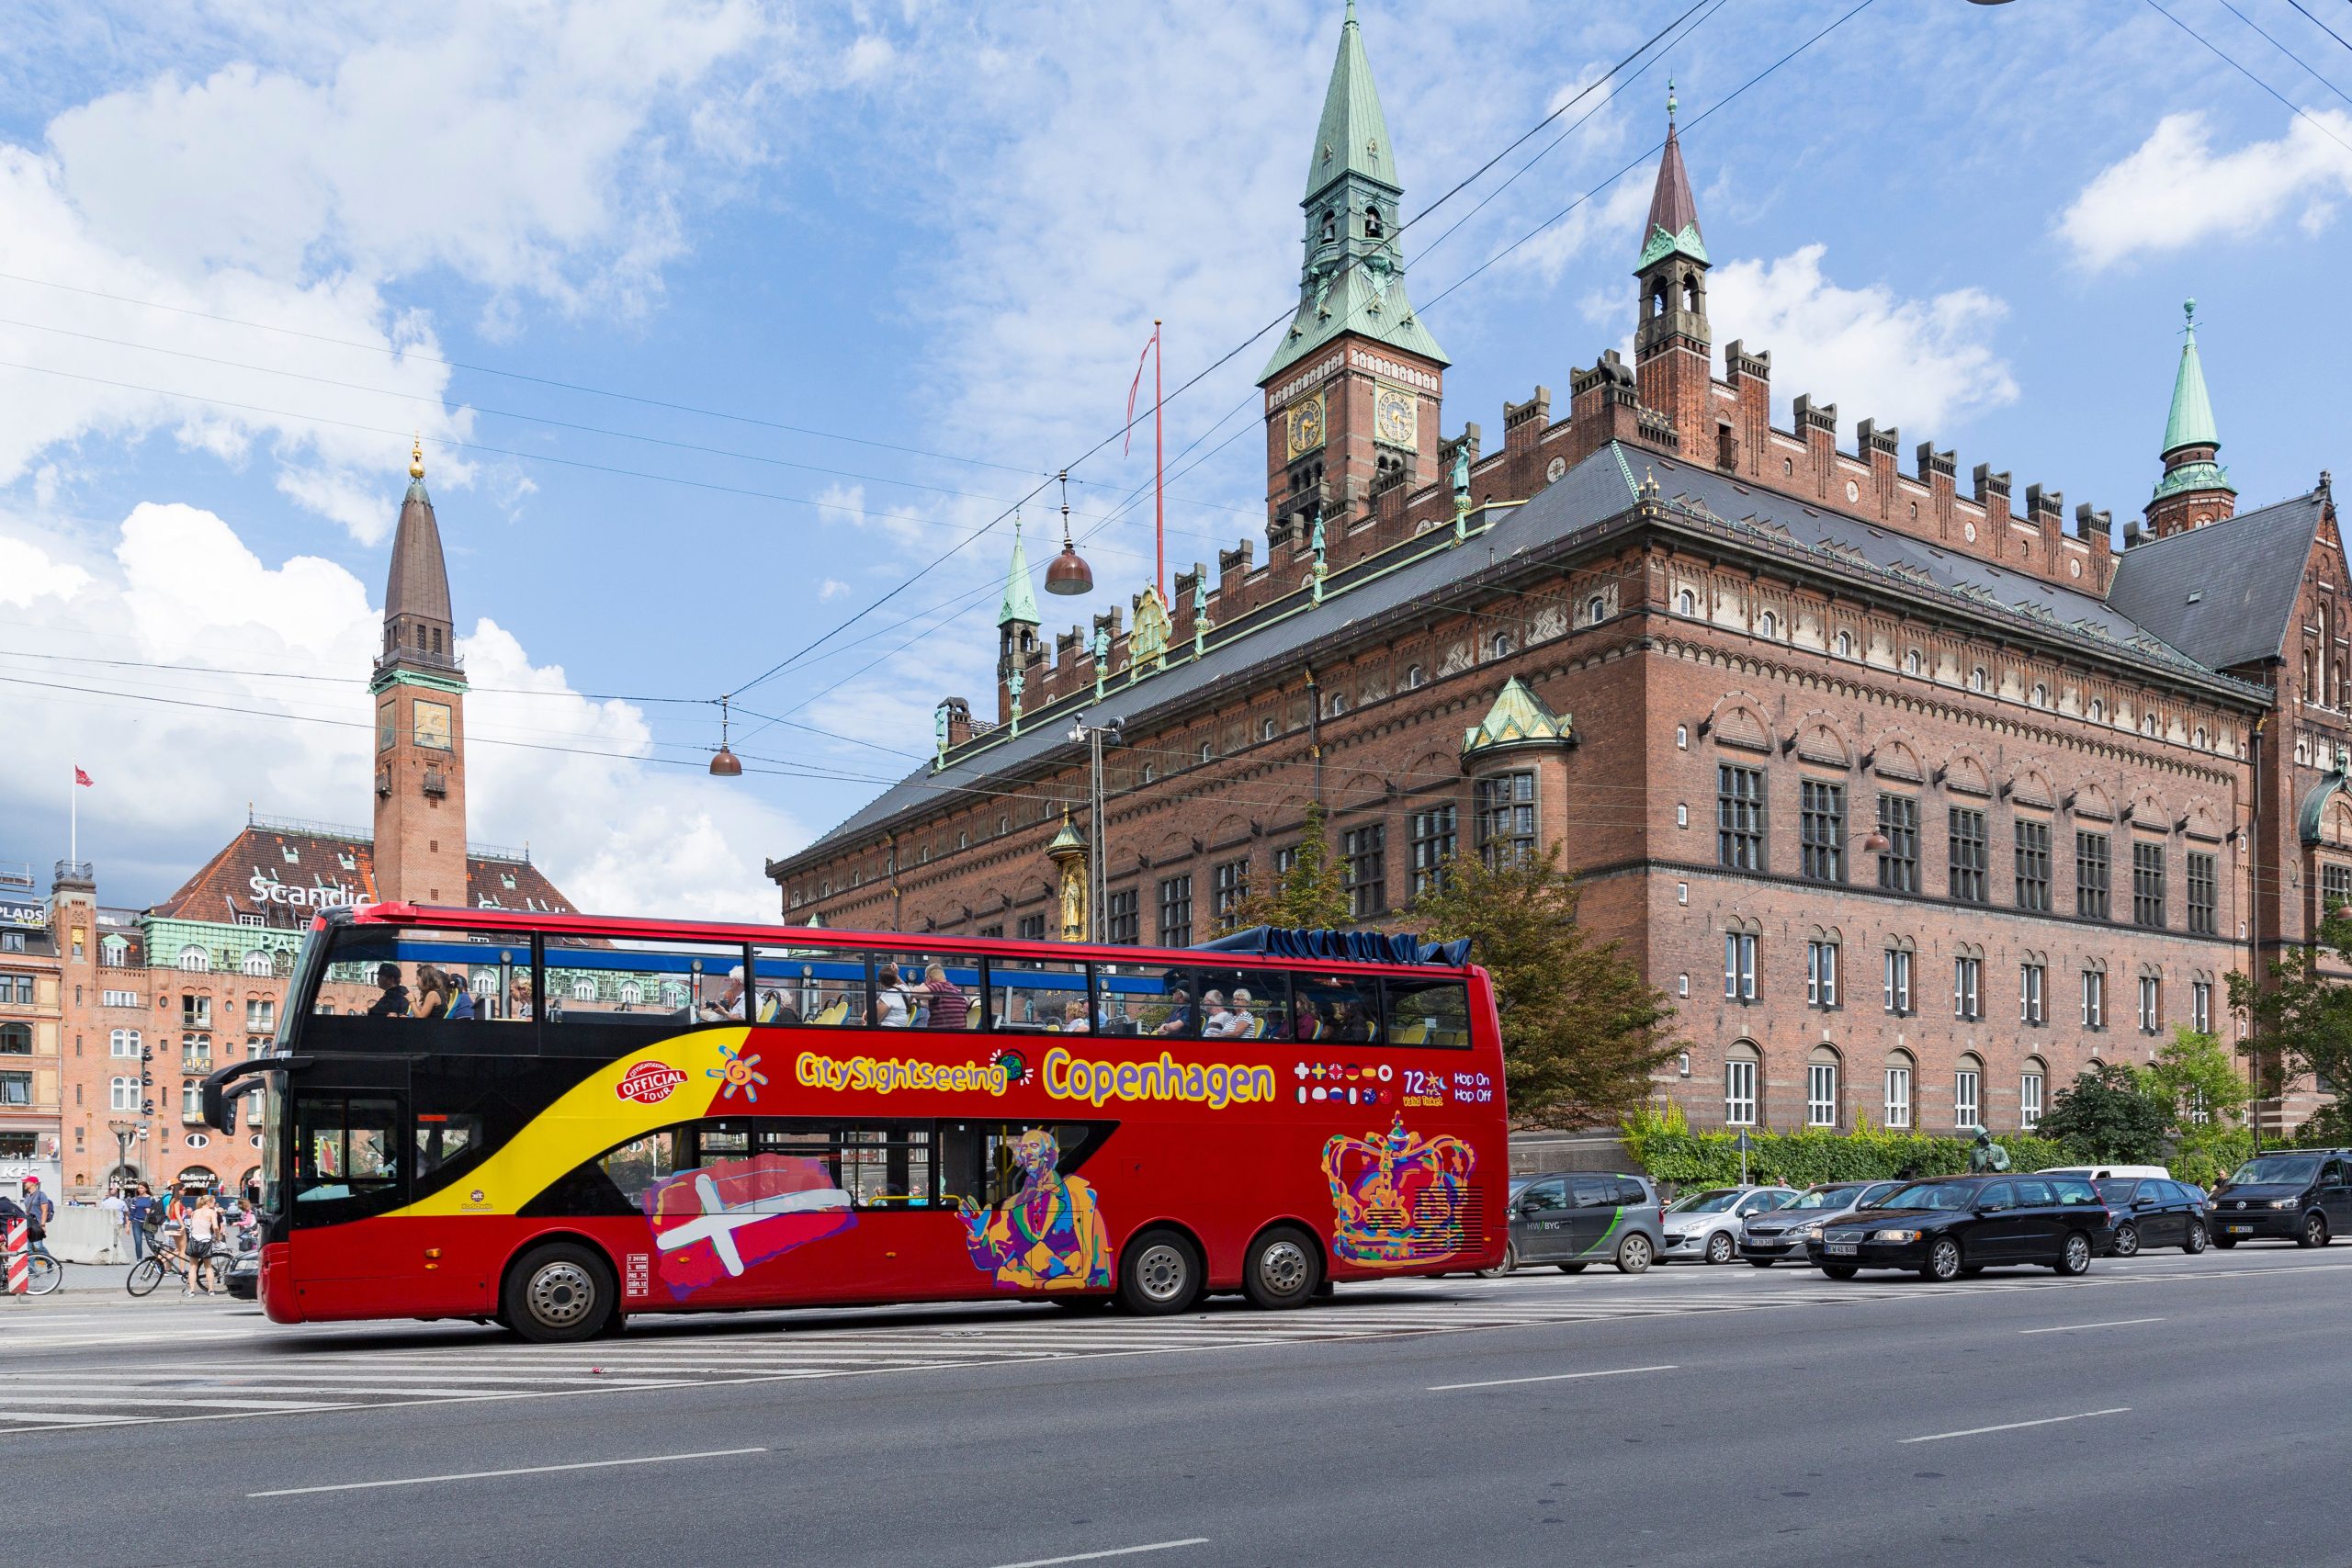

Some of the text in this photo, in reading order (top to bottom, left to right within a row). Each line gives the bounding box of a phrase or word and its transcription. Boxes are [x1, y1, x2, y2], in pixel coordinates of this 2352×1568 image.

[249, 875, 371, 908] Scandic
[622, 1071, 685, 1096] OFFICIAL
[1043, 1047, 1275, 1110] Copenhagen
[1403, 1070, 1425, 1094] 72
[1454, 1072, 1490, 1087] Hop On
[643, 1087, 672, 1101] TOUR
[1454, 1089, 1492, 1103] Hop Off
[1, 1168, 40, 1178] KFC
